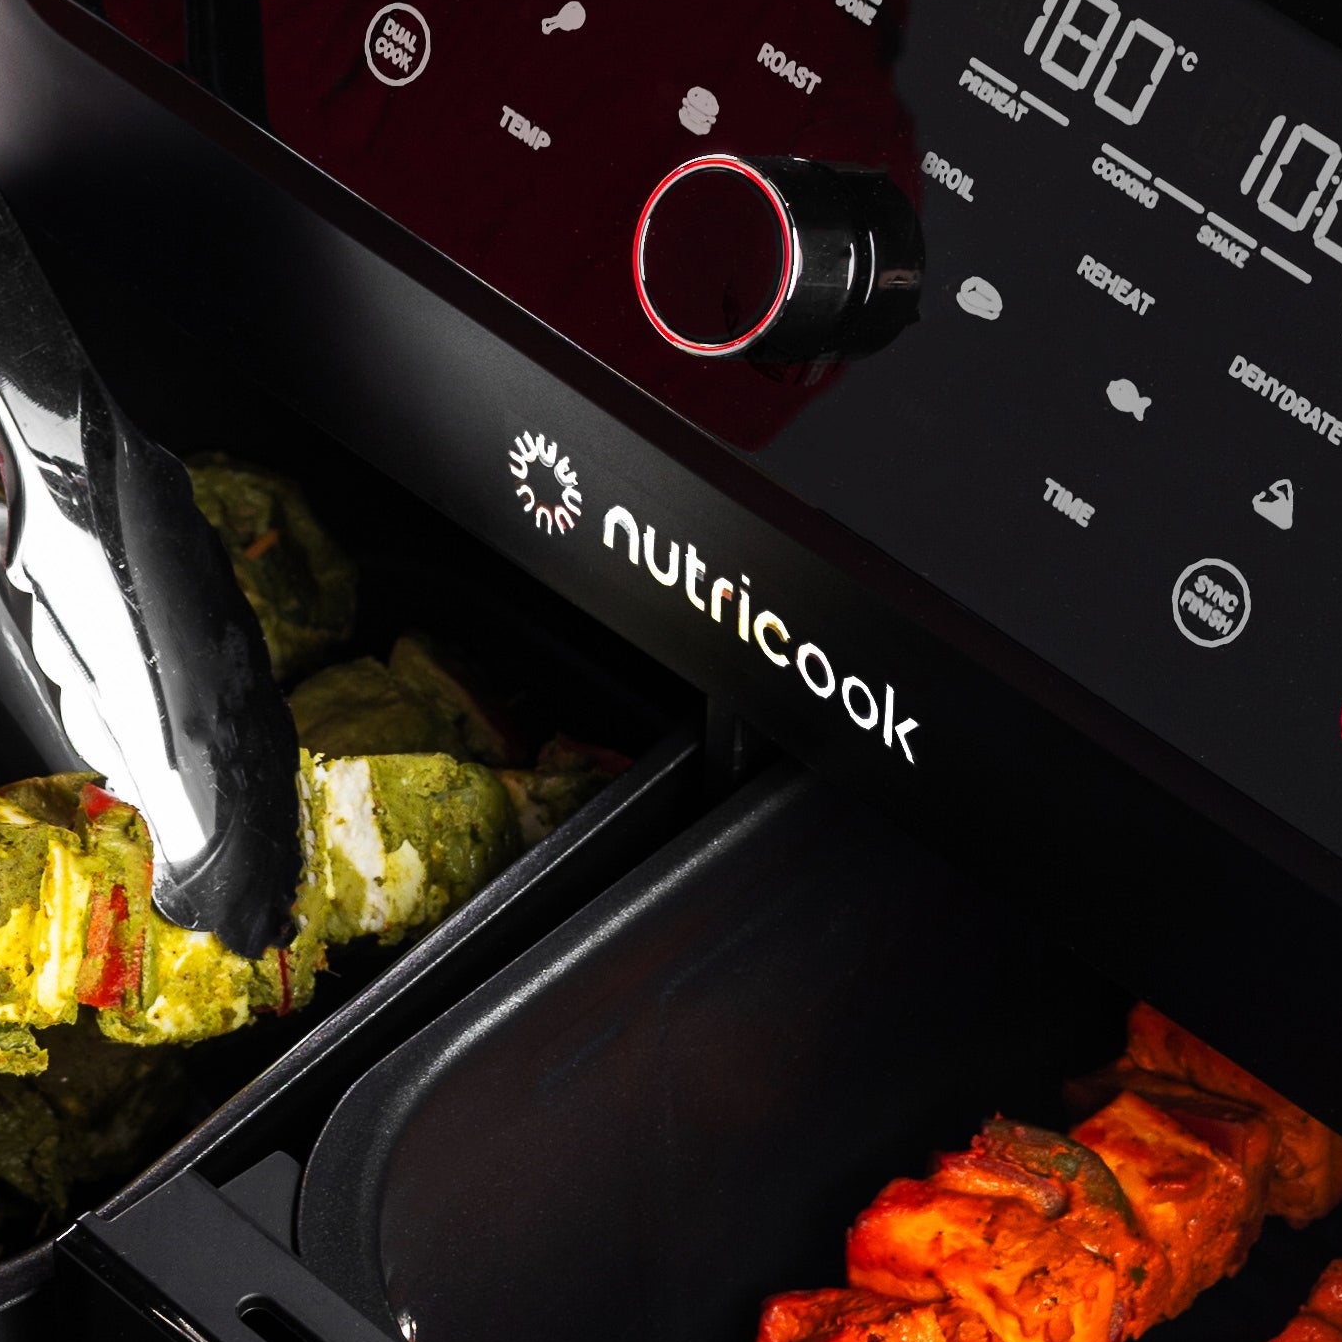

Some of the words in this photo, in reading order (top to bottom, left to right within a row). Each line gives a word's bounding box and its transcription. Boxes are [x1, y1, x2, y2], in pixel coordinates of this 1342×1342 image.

[375, 36, 413, 74] COOK
[382, 17, 417, 54] DUAL
[756, 42, 822, 95] ROAST
[499, 105, 551, 151] TEMP
[921, 151, 975, 203] BROIL
[958, 69, 1029, 122] PREHEAT
[1091, 156, 1160, 210] COOKING
[1196, 224, 1250, 269] SHAKE
[1076, 254, 1156, 317] REHEAT
[1043, 477, 1096, 528] TIME
[1179, 589, 1234, 636] FINISH
[1193, 574, 1239, 613] SYNC
[602, 504, 920, 765] nutricook
